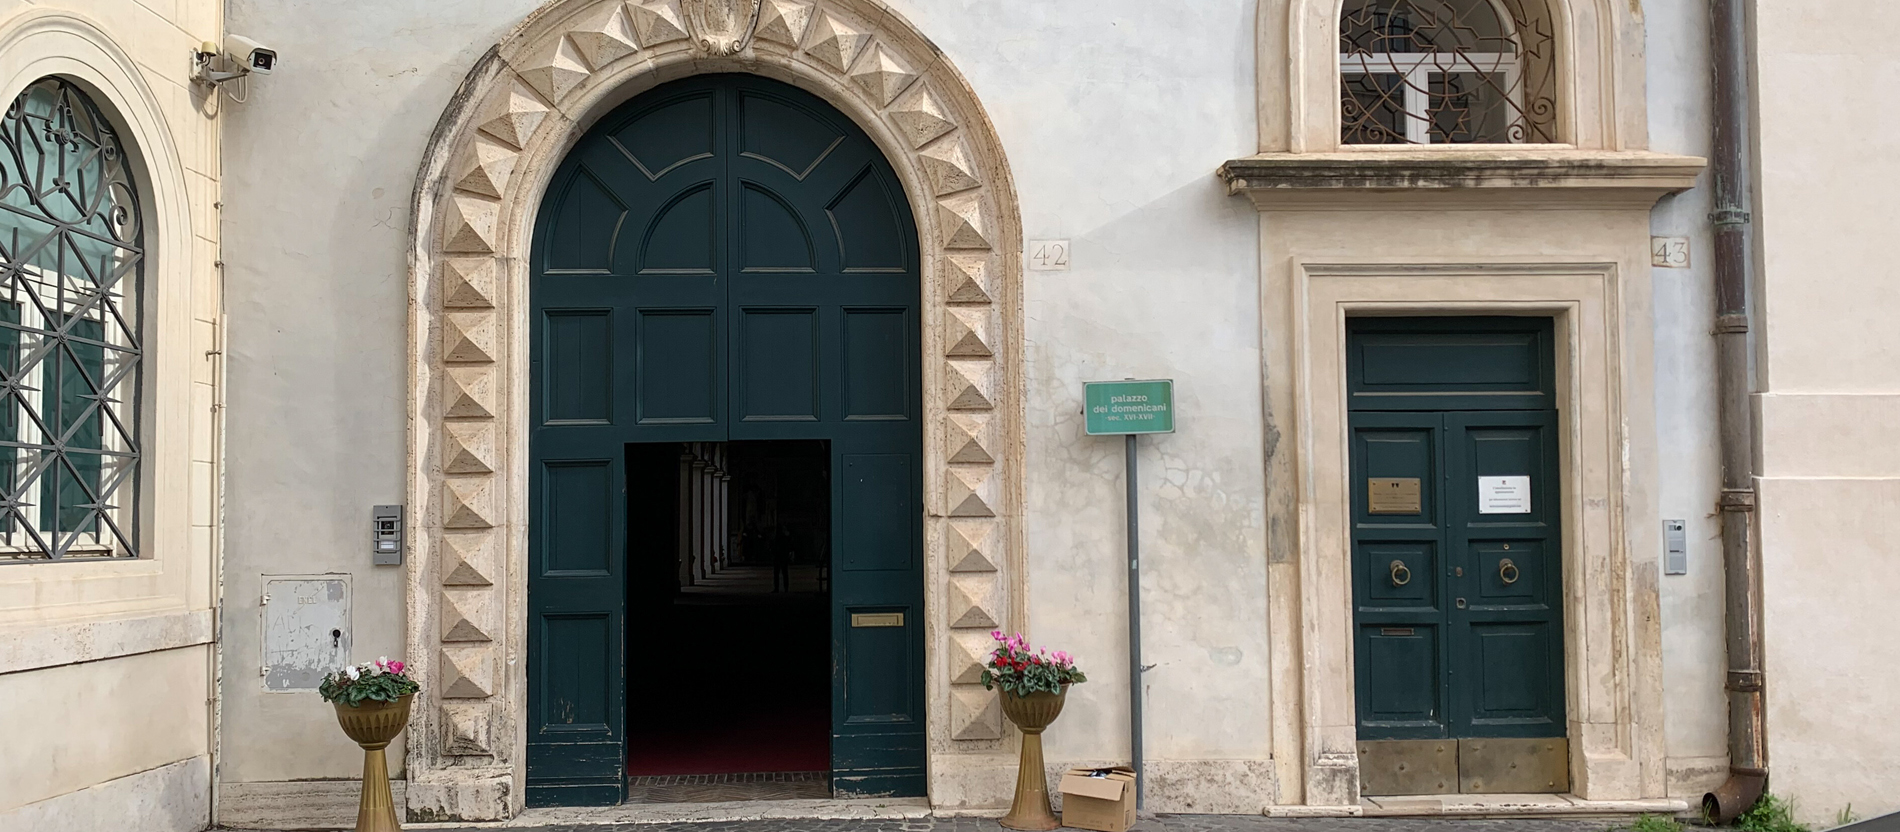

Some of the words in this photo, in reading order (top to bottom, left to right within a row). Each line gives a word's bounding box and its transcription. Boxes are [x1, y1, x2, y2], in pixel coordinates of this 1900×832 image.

[1033, 244, 1067, 265] 42
[1655, 242, 1687, 263] 43
[1111, 394, 1148, 404] palazzo
[1093, 405, 1108, 413] dei
[1111, 403, 1167, 413] domenicani
